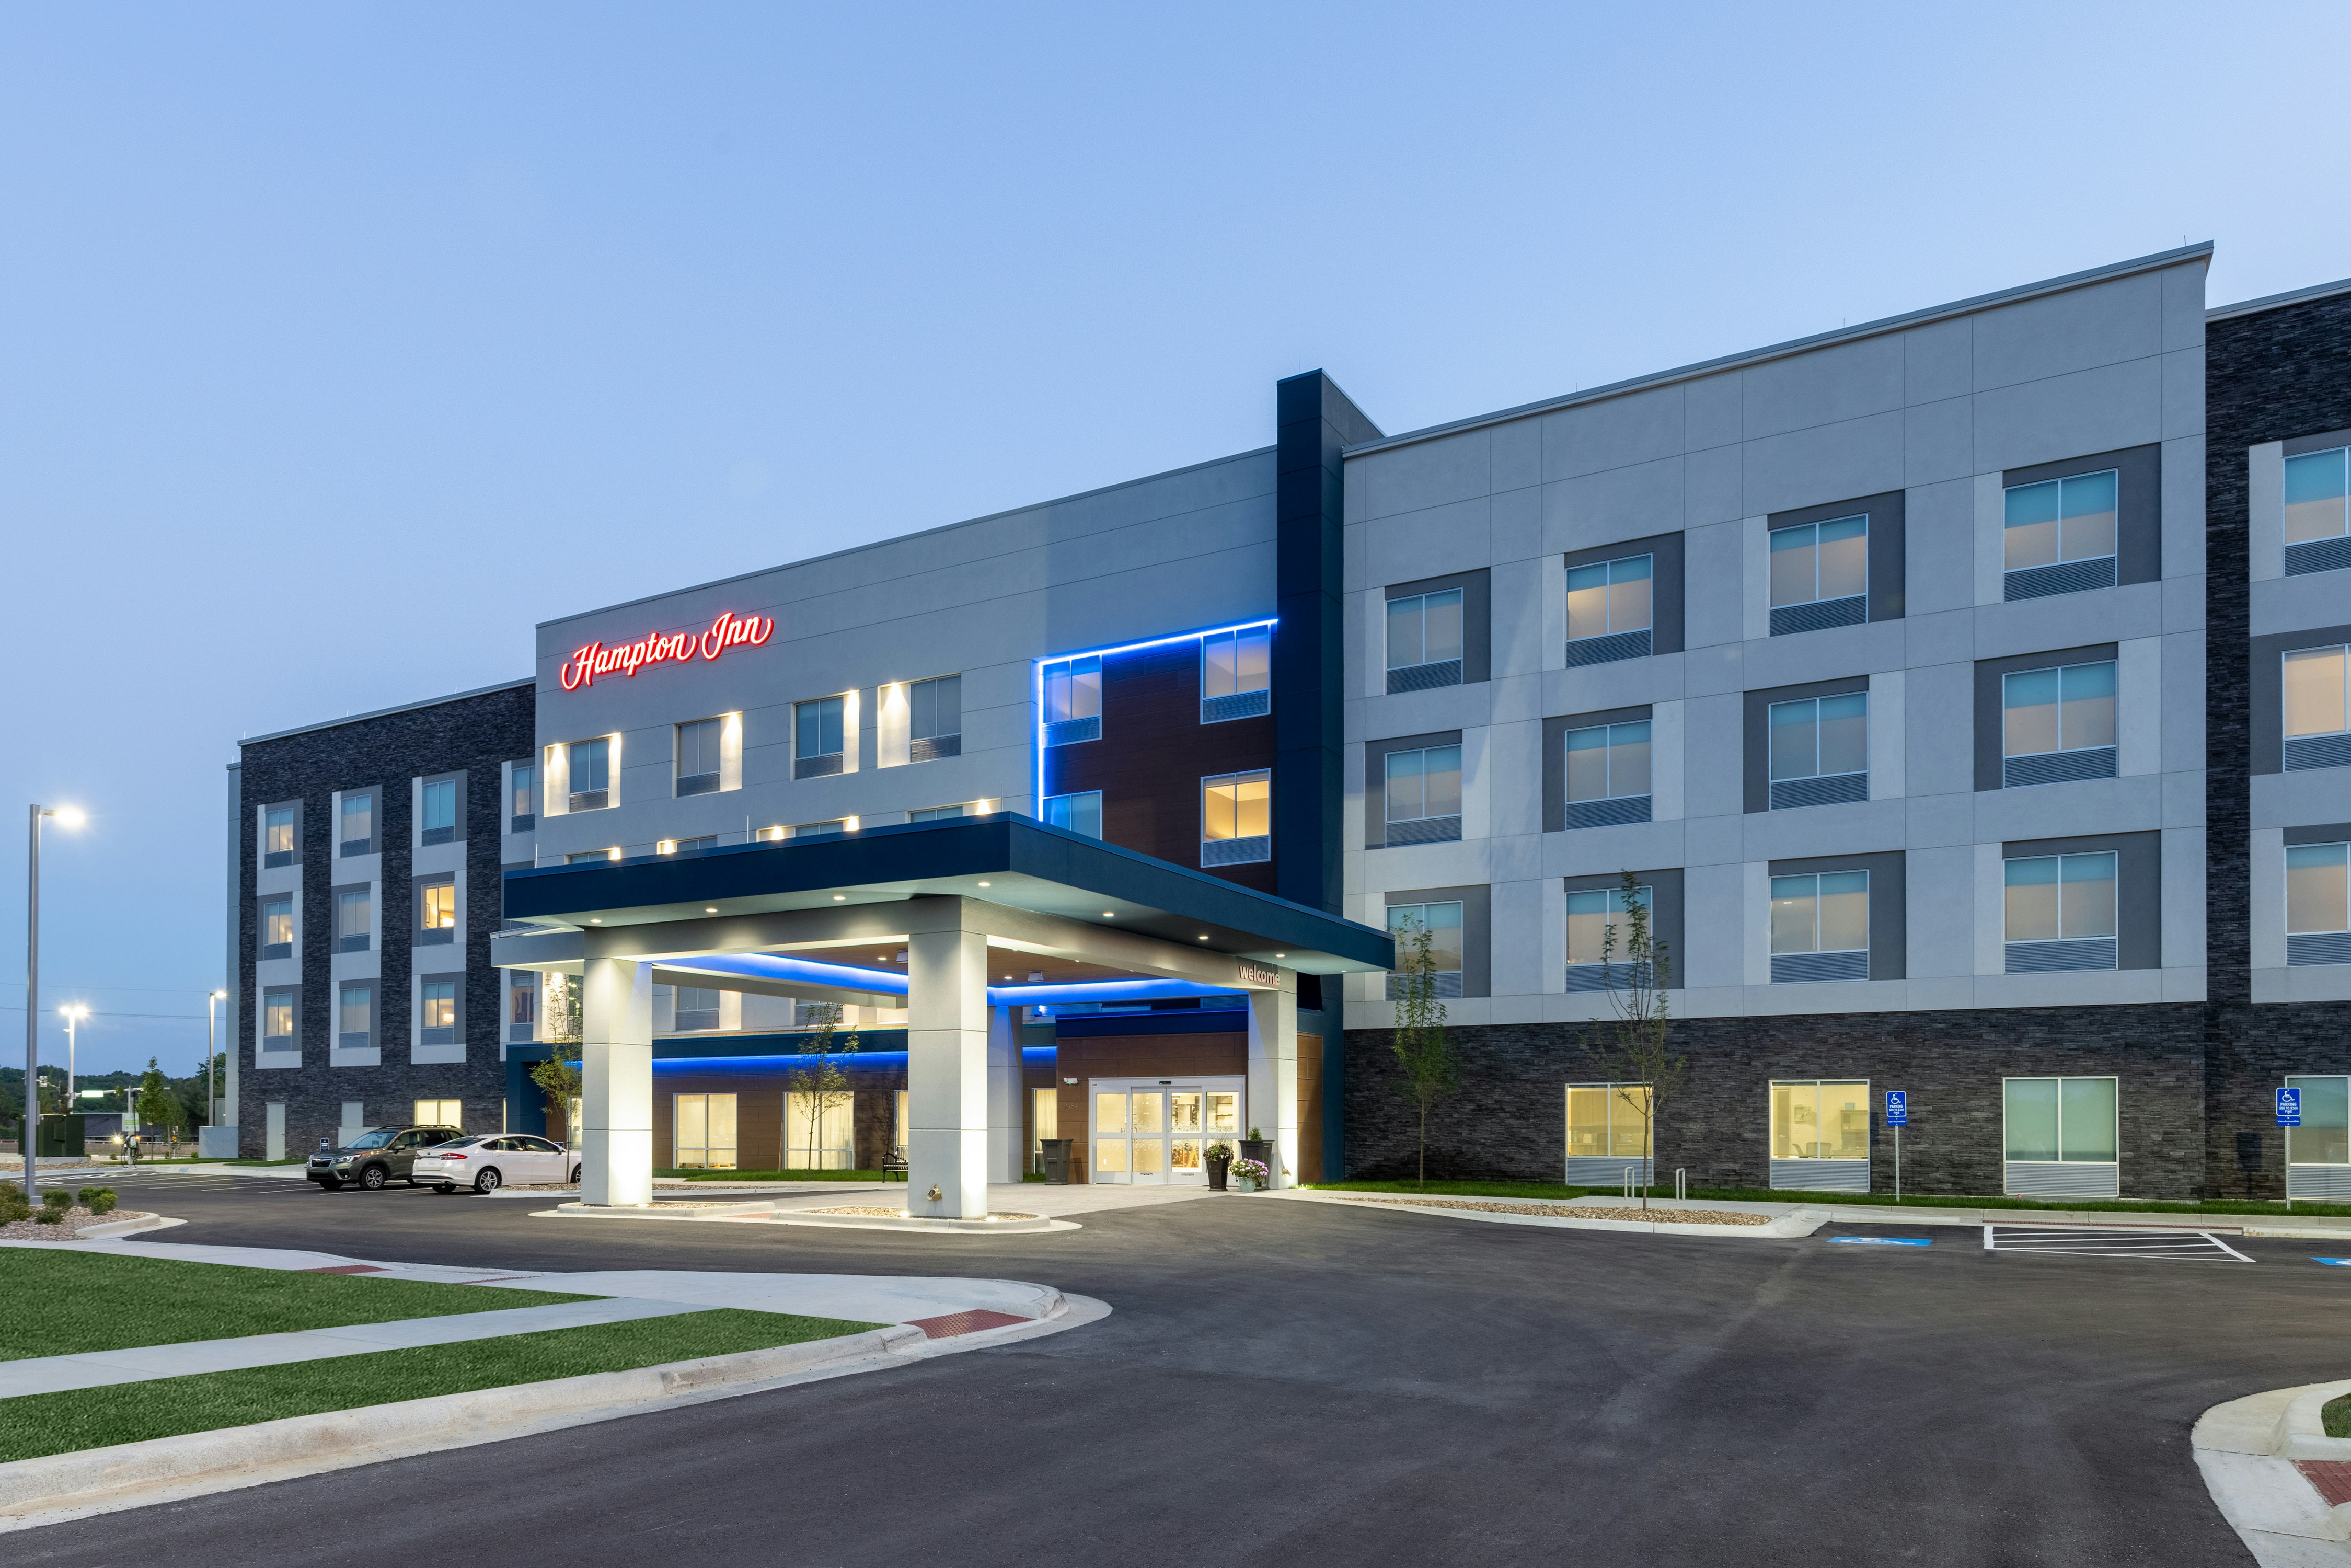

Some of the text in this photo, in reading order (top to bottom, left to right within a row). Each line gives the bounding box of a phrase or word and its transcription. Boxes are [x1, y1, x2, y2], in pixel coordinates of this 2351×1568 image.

[561, 612, 774, 690] Hampton Inn
[1238, 964, 1280, 985] welcome
